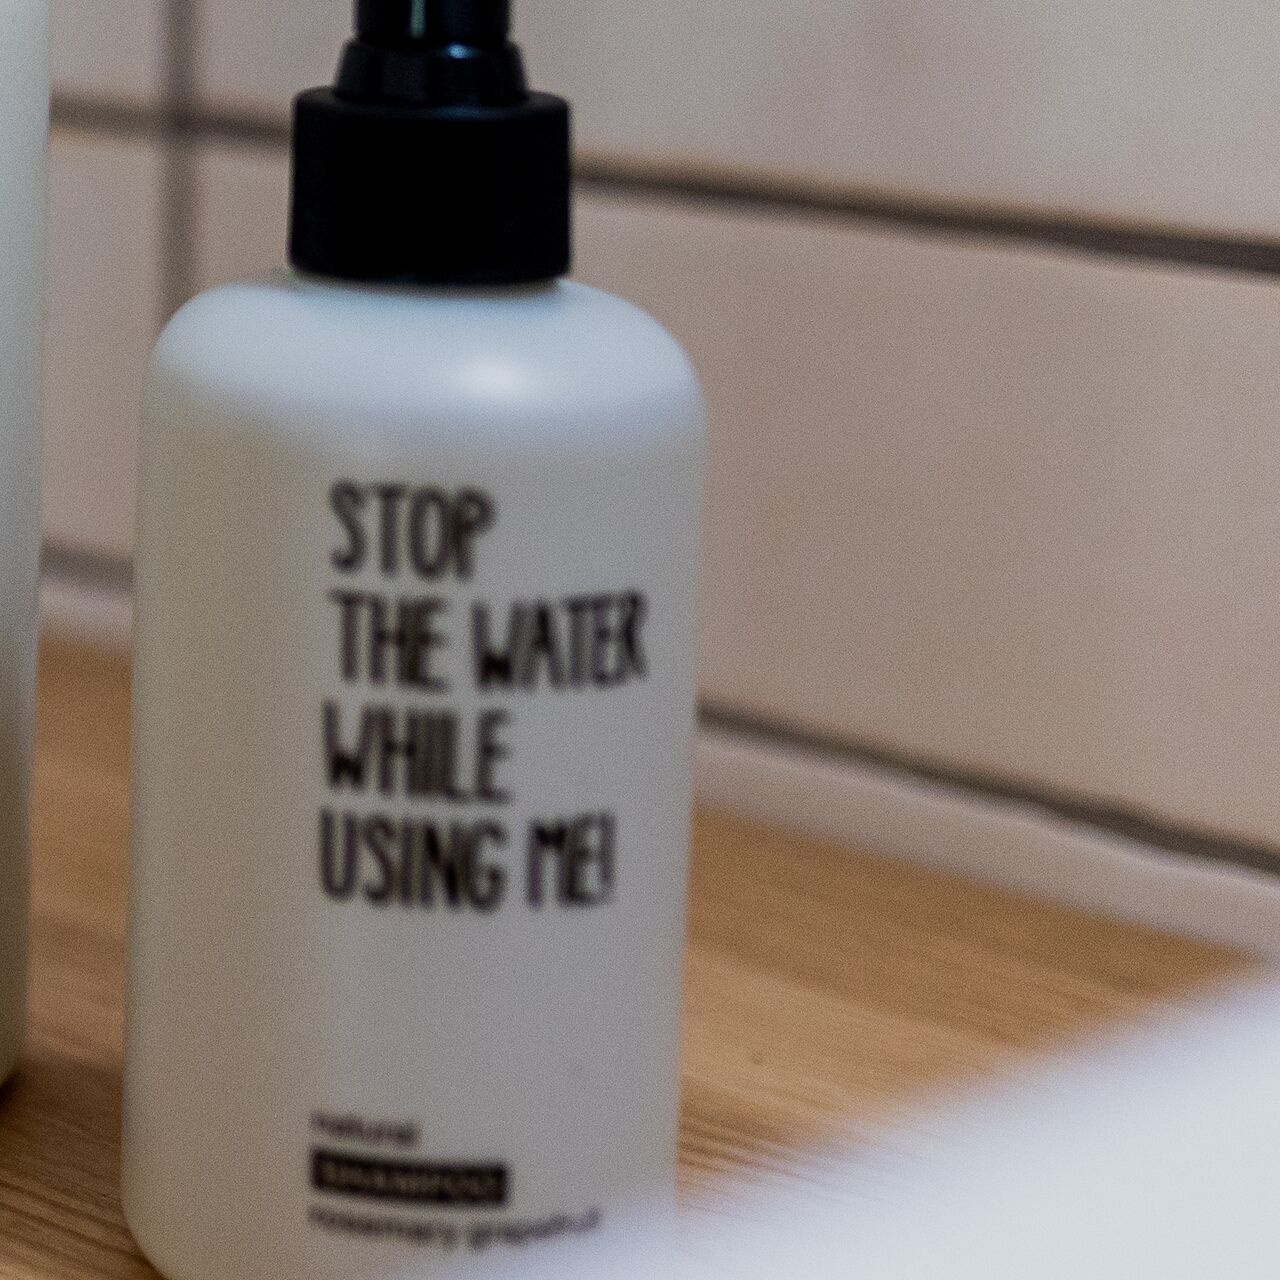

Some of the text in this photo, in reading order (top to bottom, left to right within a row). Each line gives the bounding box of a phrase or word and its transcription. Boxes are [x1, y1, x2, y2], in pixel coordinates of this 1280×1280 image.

[328, 478, 497, 581] STOP
[328, 587, 648, 693] THE WATER
[322, 697, 511, 805] WHILE
[319, 805, 509, 914] USING
